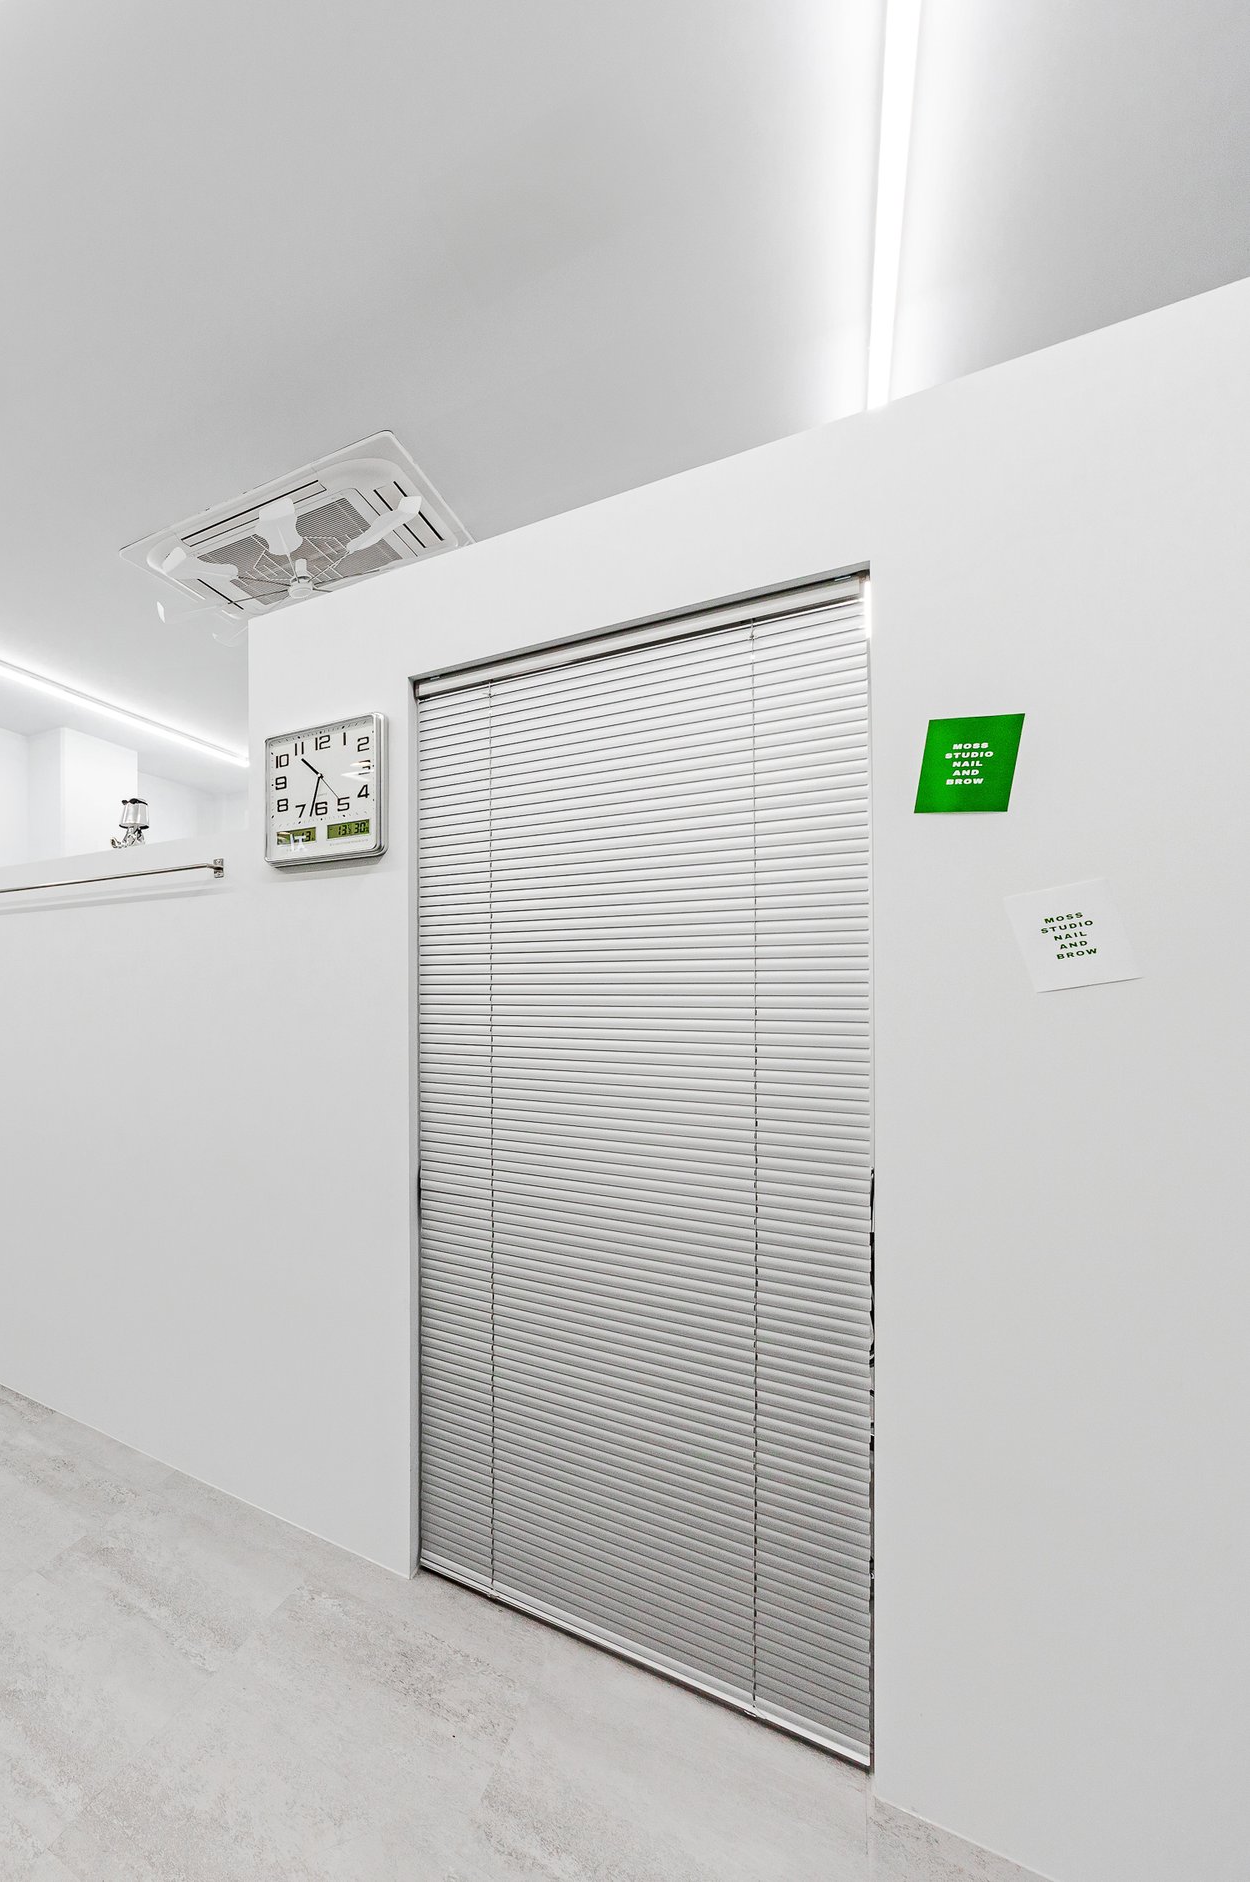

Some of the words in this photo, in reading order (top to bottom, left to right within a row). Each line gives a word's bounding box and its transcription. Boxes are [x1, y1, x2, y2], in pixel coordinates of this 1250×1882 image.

[315, 735, 330, 750] 12
[343, 732, 346, 746] 1
[357, 737, 369, 752] 2
[295, 742, 304, 756] 11
[945, 751, 993, 759] STUDIO
[276, 754, 289, 768] 10
[275, 776, 287, 790] 9
[357, 785, 369, 798] 4
[277, 798, 288, 812] 8
[295, 804, 306, 818] 7
[315, 802, 327, 815] 6
[337, 797, 350, 811] 5
[1044, 912, 1083, 924] MOSS
[1041, 920, 1093, 934] STUDIO
[1054, 931, 1087, 941] NAIL
[1060, 941, 1088, 949] AND
[1057, 948, 1097, 959] BROW
